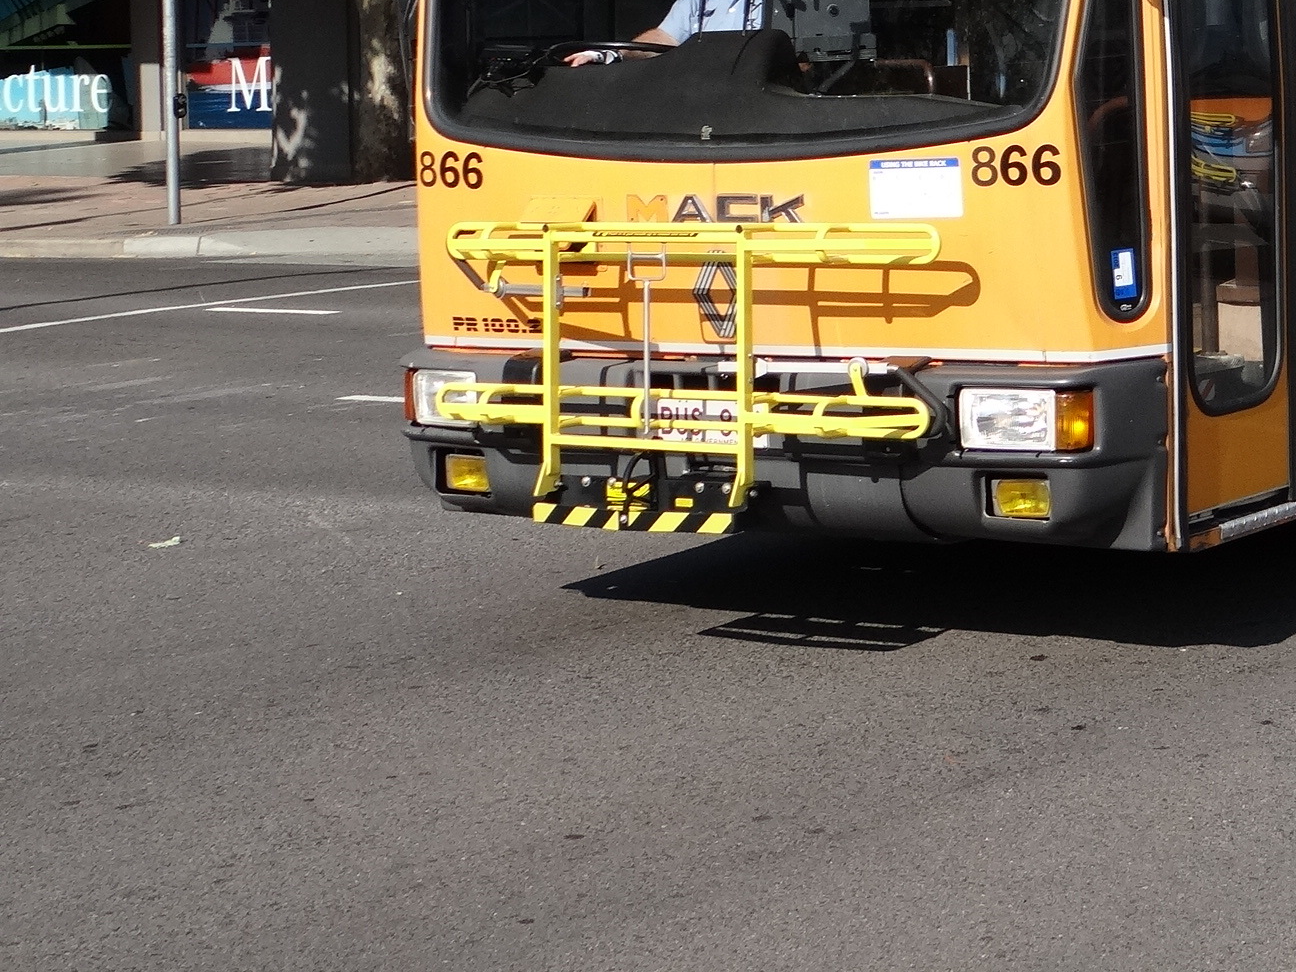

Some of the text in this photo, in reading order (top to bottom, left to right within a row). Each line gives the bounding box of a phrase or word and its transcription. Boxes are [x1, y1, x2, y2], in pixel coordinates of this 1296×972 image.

[0, 64, 112, 113] cture
[419, 151, 483, 189] 866
[971, 144, 1061, 187] 866
[626, 193, 804, 223] MACK
[452, 316, 478, 332] PR
